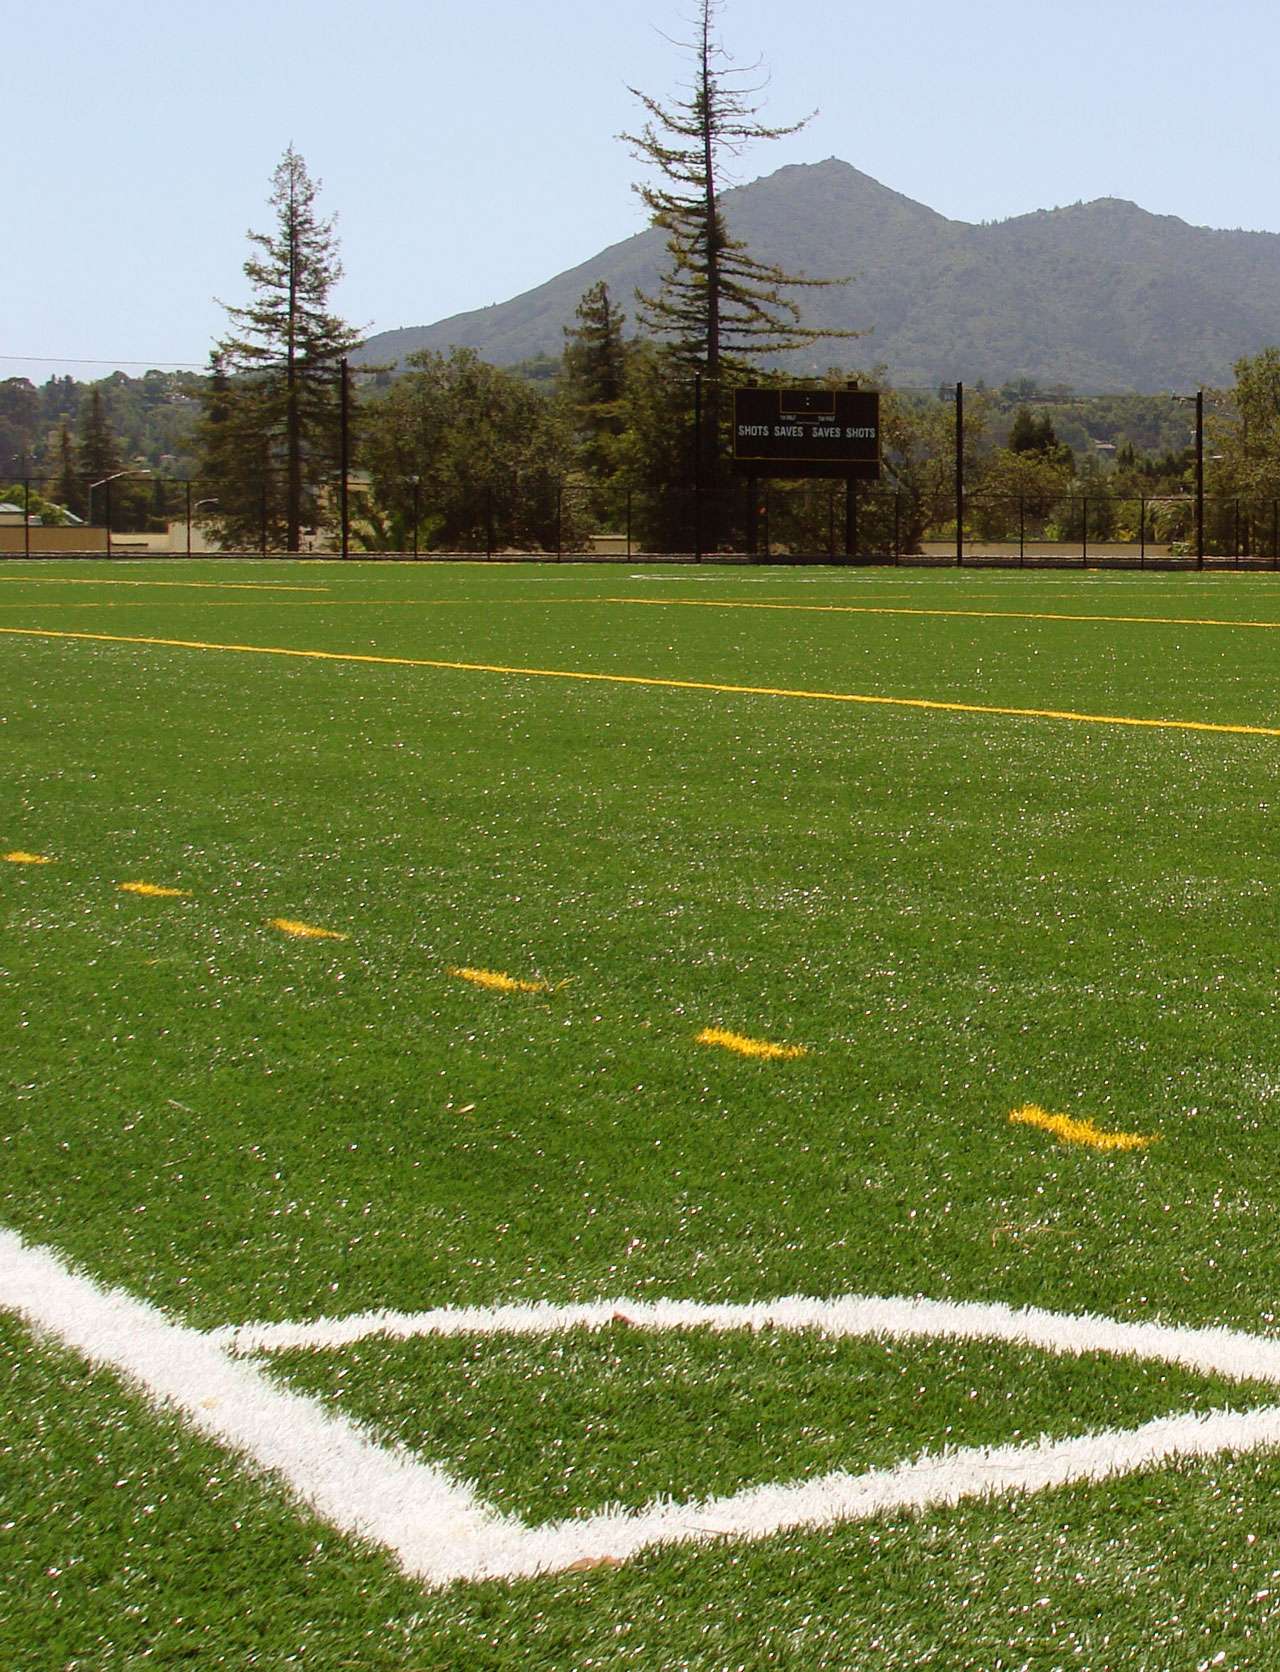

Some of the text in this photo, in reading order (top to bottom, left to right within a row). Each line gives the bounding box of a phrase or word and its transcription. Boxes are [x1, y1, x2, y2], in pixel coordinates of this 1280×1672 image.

[738, 425, 876, 438] SHOTS SAVES SAVES SHOTS
